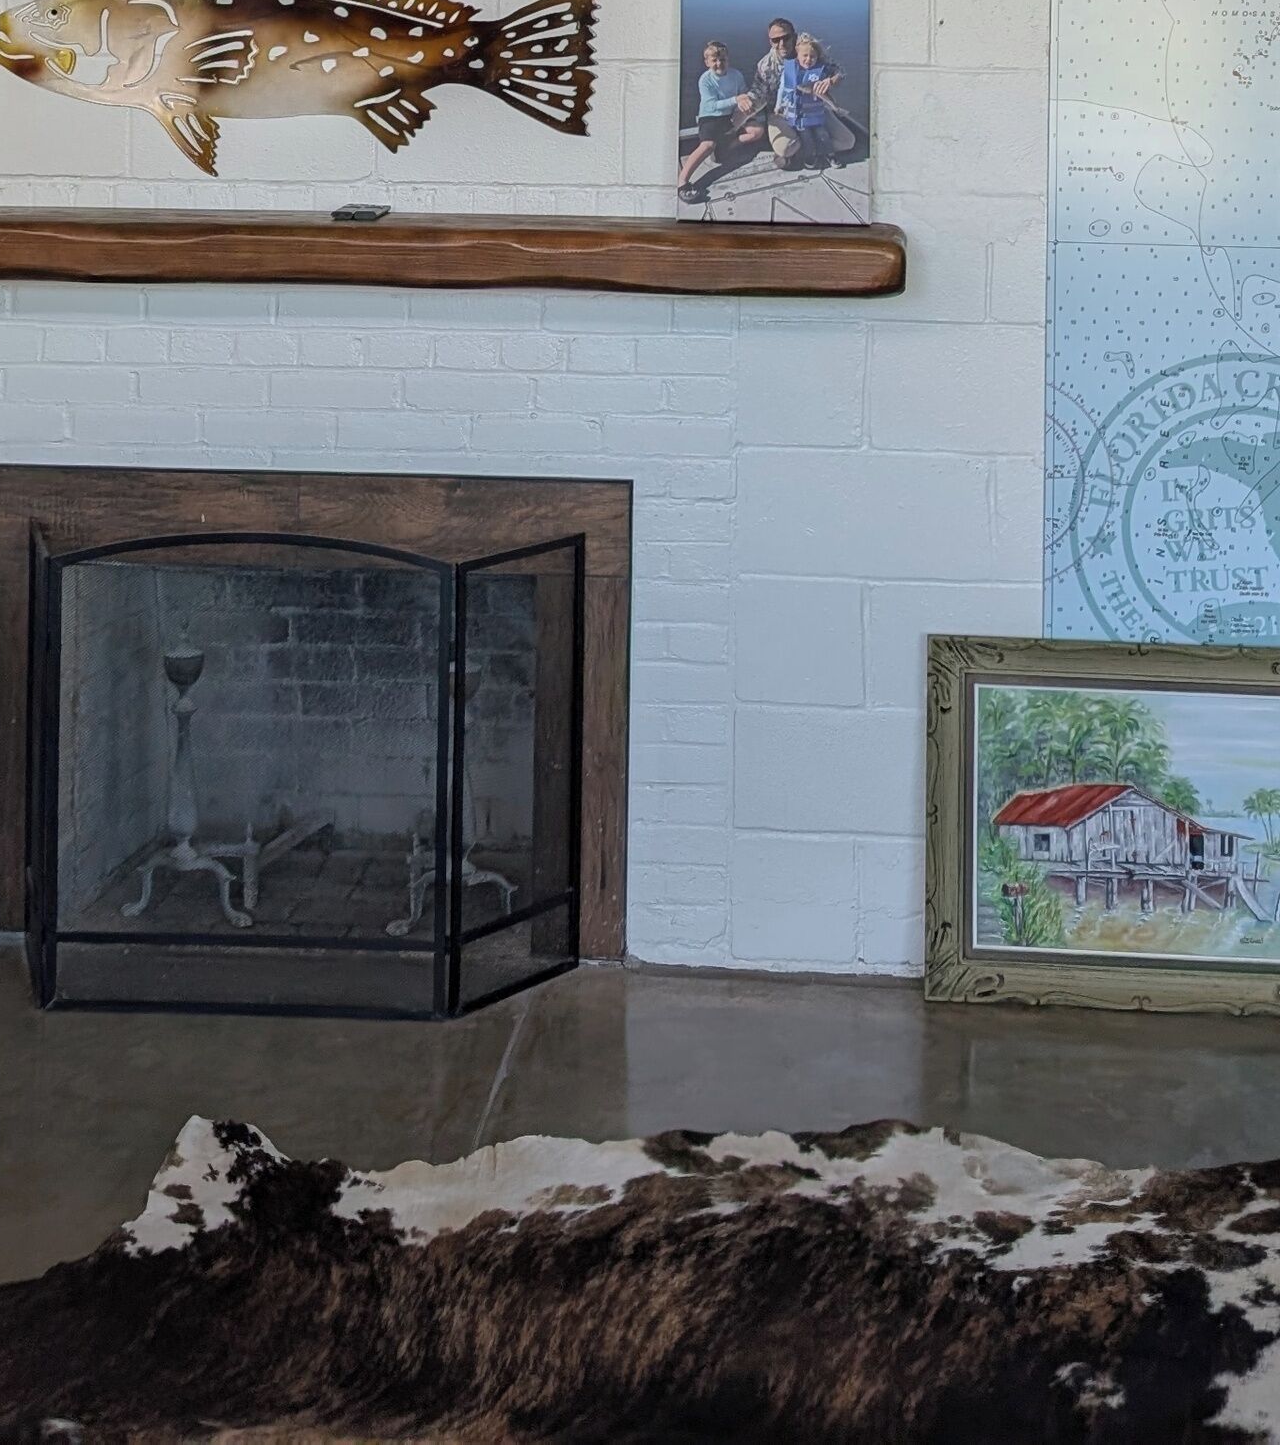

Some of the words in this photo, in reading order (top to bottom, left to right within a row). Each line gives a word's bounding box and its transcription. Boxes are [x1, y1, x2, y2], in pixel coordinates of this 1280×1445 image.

[1088, 369, 1222, 510] FLORIDA
[1160, 478, 1194, 503] IN
[1163, 506, 1256, 532] GRITS
[1163, 539, 1218, 564] WE
[1165, 566, 1269, 594] TRUST
[1099, 570, 1145, 632] THE
